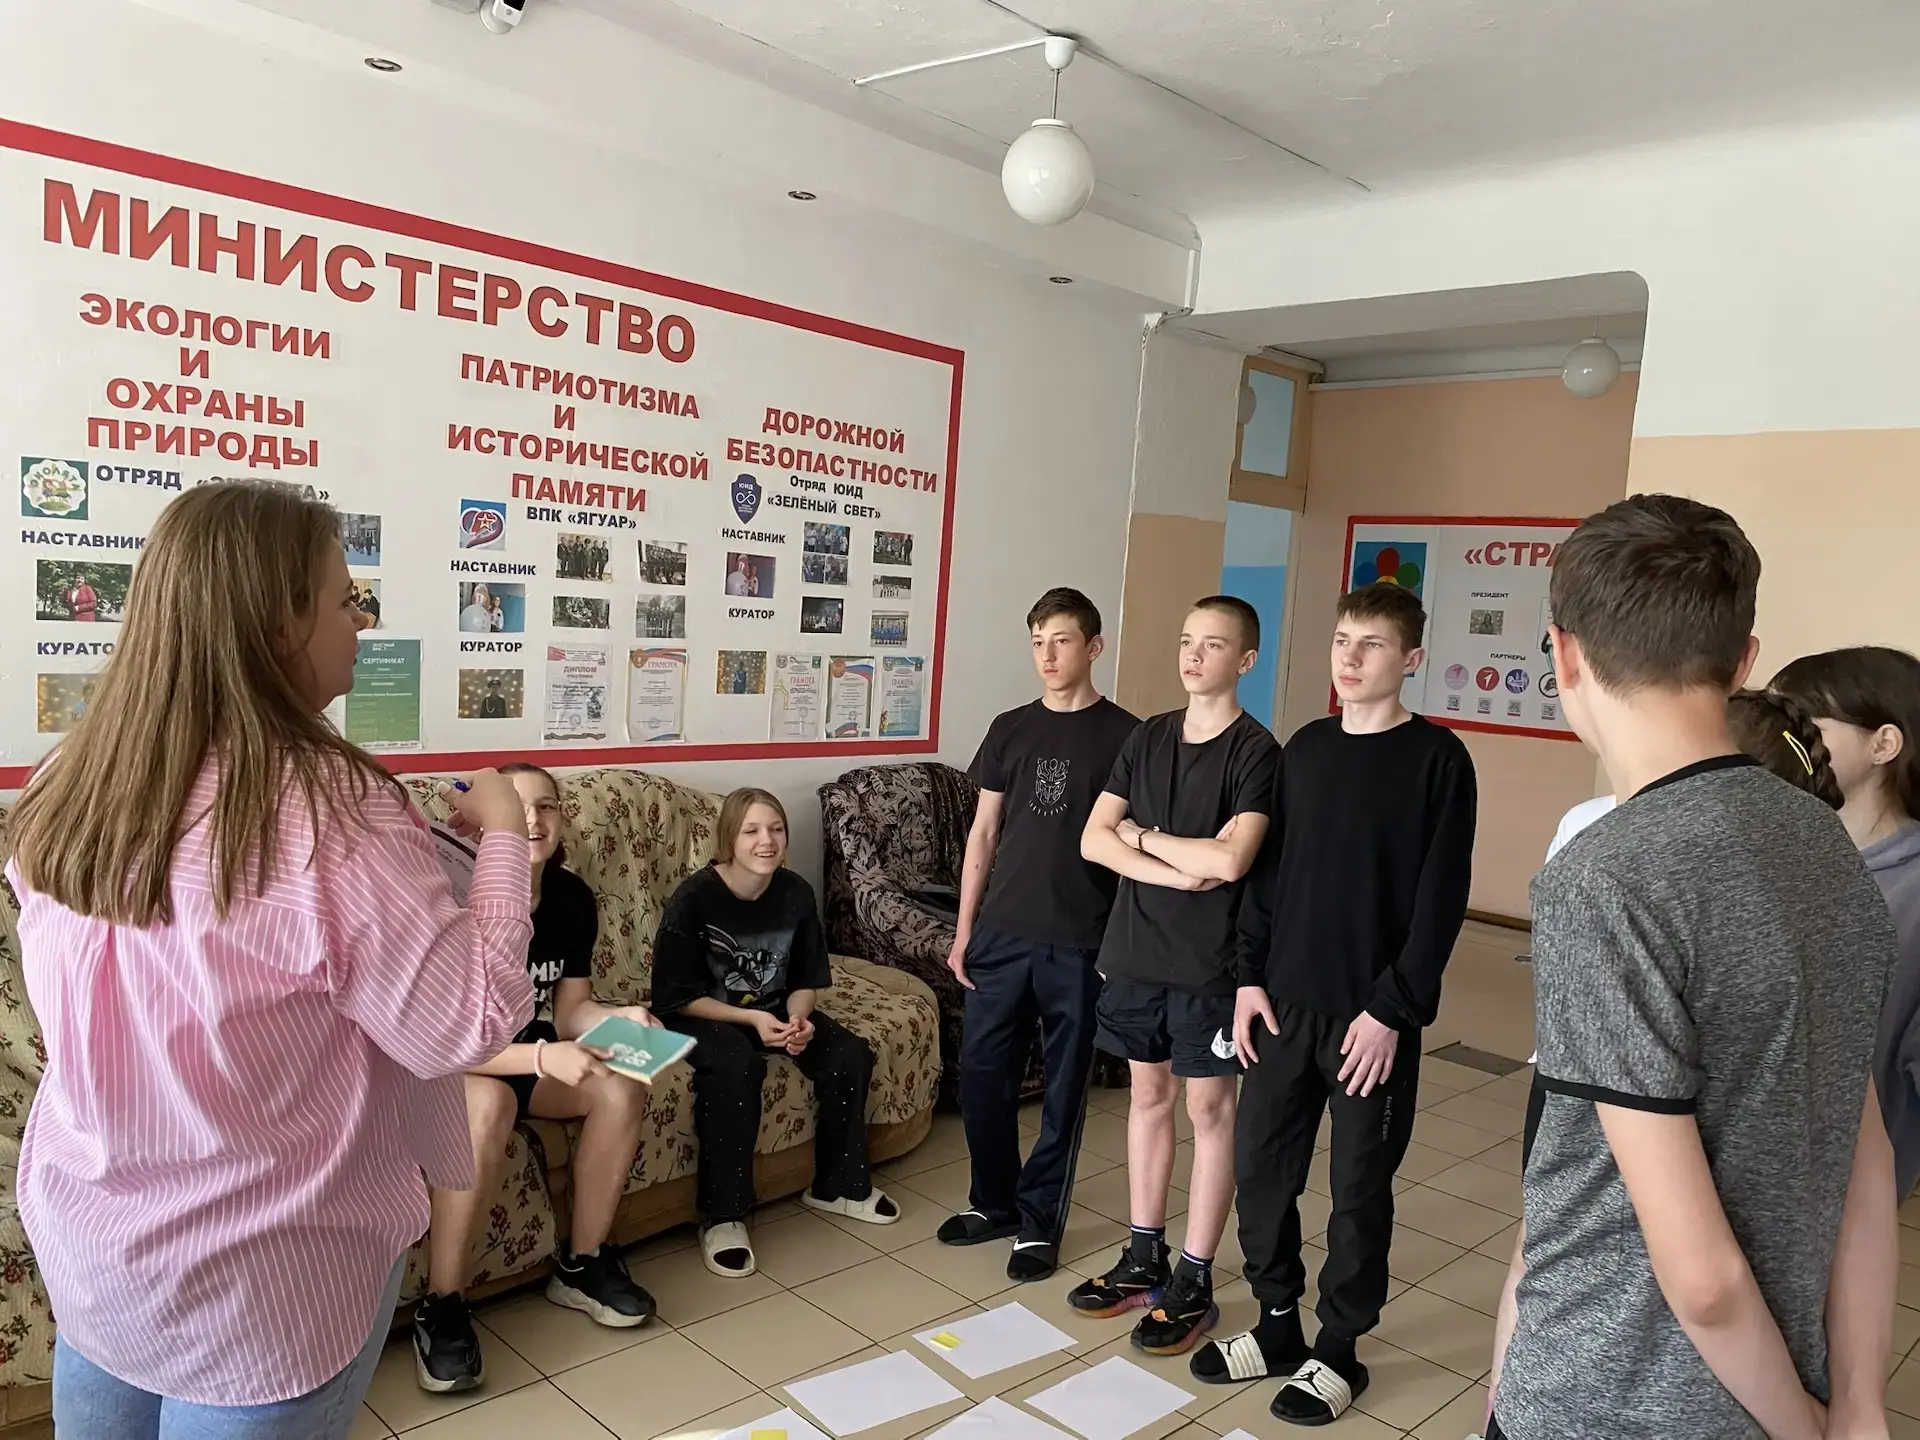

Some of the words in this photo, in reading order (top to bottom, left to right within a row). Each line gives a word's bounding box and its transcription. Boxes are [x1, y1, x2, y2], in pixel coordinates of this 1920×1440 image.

[44, 177, 695, 363] МИНИСТЕРСТВО
[79, 292, 330, 360] ЭКОЛОГИИ
[179, 346, 209, 379] И
[461, 353, 700, 419] ПАТРИОТИЗМА
[106, 377, 304, 428] ОХРАНЫ
[553, 404, 575, 431] И
[87, 416, 318, 470] ПРИРОДЫ
[762, 407, 905, 454] ДОРОЖНОЙ
[447, 423, 709, 481] ИСТОРИЧЕСКОЙ
[96, 465, 182, 491] ОТРЯД
[726, 438, 937, 493] БЕЗОПАСТНОСТИ
[511, 473, 646, 512] ПАМЯТИ
[738, 482, 753, 491] ЮИД
[790, 475, 826, 493] Отряд
[833, 482, 863, 500] ЮИД
[526, 506, 562, 523] ВПК
[567, 507, 637, 530] «ЯГУАР»
[767, 494, 837, 514] «ЗЕЛЁНЫЙ
[843, 503, 881, 519] СВЕТ»
[21, 530, 147, 550] НАСТАВНИК
[722, 527, 786, 544] НАСТАВНИК
[450, 560, 536, 576] НАСТАВНИК
[728, 607, 775, 620] КУРАТОР
[37, 642, 116, 656] КУРАТО
[460, 641, 523, 653] КУРАТОР
[1490, 652, 1526, 661] ПАРТНЕРЫ
[362, 657, 405, 665] СЕРТИФИКАТ
[563, 665, 597, 674] ДИПЛОМ
[647, 660, 678, 670] ГРАМОТА
[790, 676, 815, 685] ГРАМОТА
